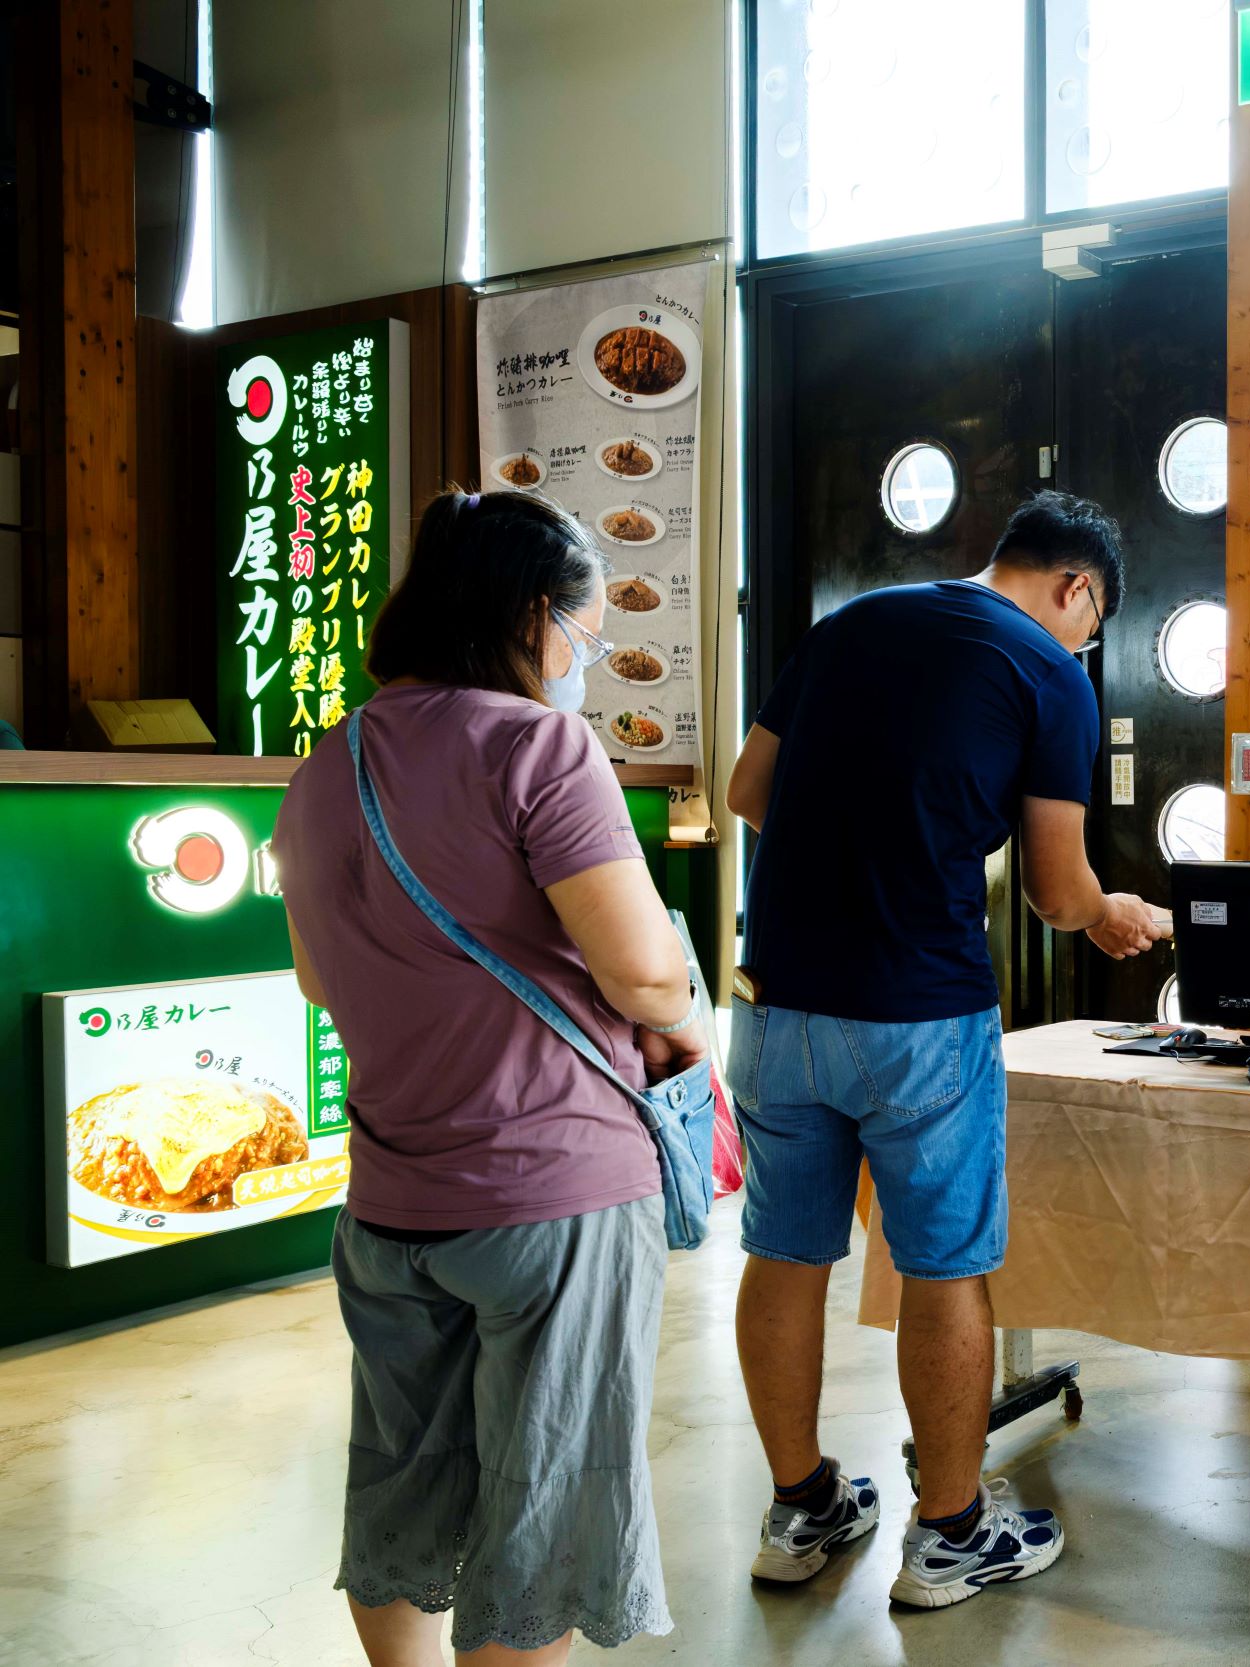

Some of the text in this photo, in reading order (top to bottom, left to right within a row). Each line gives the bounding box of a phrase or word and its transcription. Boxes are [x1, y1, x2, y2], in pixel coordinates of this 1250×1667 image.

[496, 375, 573, 397] とんかつカレー
[292, 374, 309, 458] カレールウ
[671, 574, 690, 584] 白身
